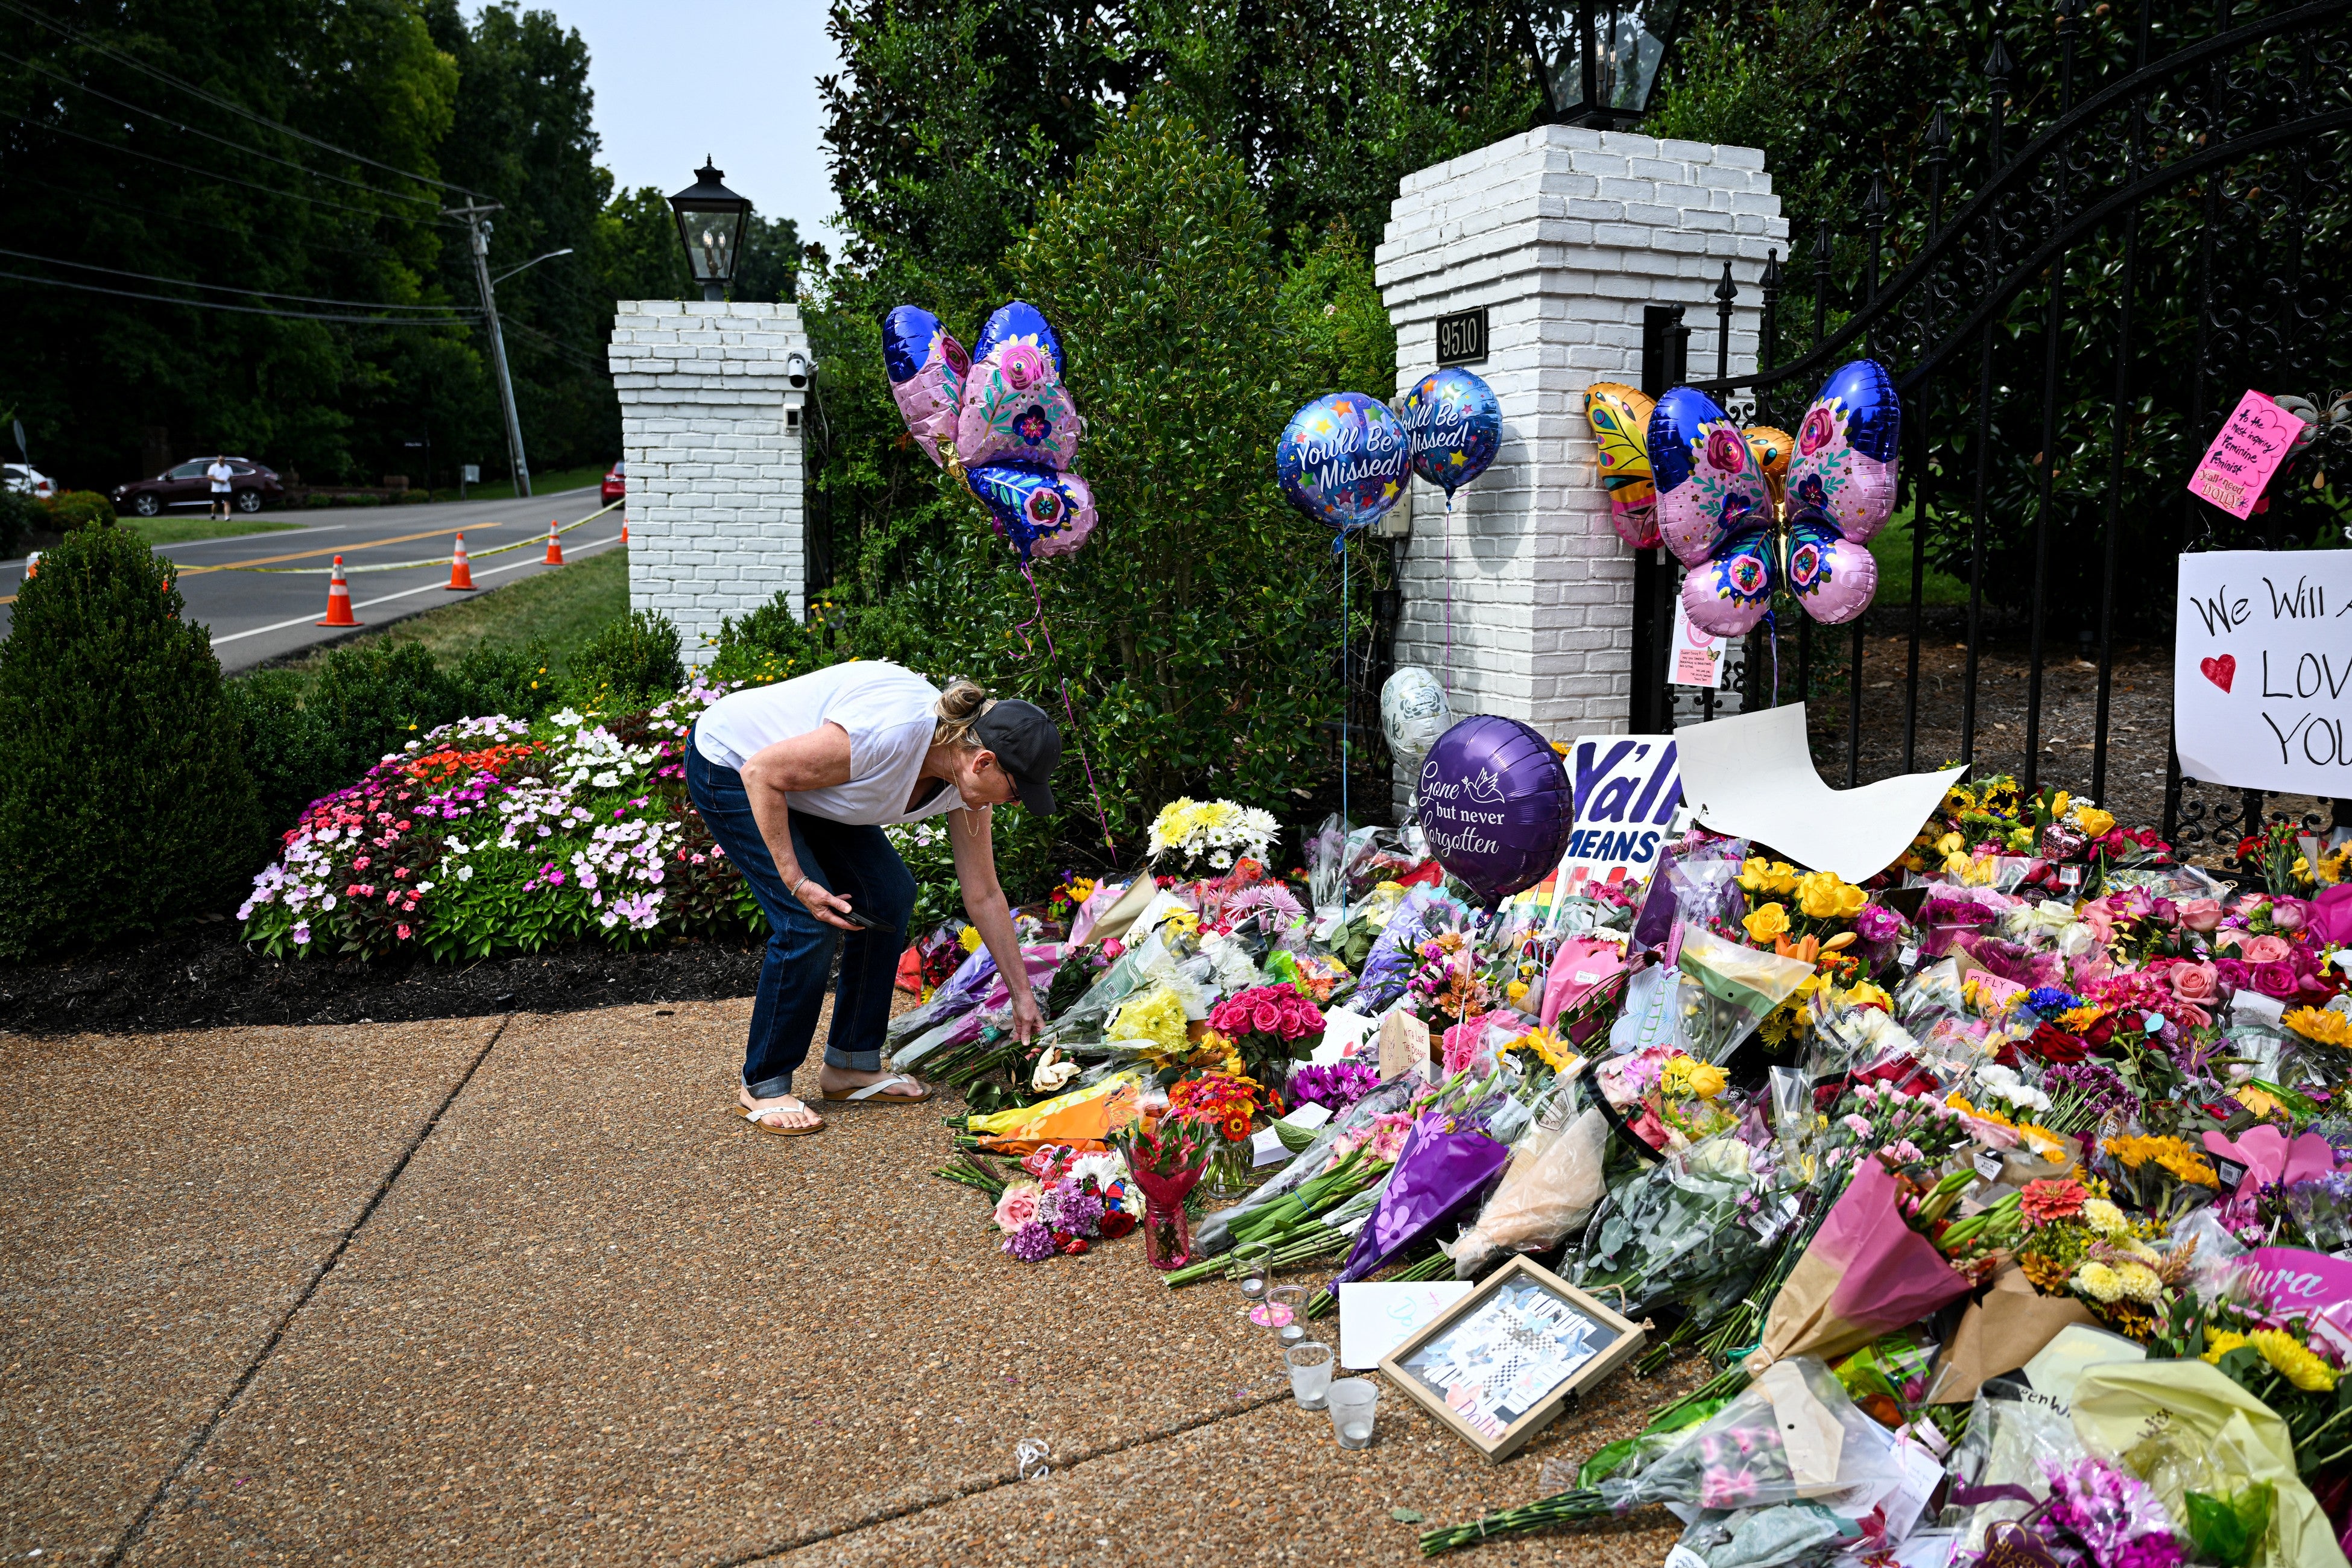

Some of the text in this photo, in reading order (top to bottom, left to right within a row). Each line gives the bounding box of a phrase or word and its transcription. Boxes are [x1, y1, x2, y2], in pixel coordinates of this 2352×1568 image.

[1442, 318, 1478, 357] 9510
[1437, 402, 1459, 427] Be
[2239, 409, 2265, 429] to the
[1297, 426, 1393, 469] You'll Be
[2231, 422, 2279, 454] most inspiring
[1320, 447, 1403, 493] Missed!
[2201, 483, 2242, 510] DOLLY
[2222, 478, 2245, 496] need
[2190, 575, 2324, 637] We Will
[1418, 760, 1460, 808] Gone
[1436, 801, 1505, 826] but never
[1421, 809, 1500, 858] Forgotten
[1567, 829, 1660, 864] MEANS
[1391, 906, 1433, 941] icke
[1984, 976, 2006, 990] FLY
[2233, 1026, 2284, 1037] Sunflowers
[1402, 1042, 1411, 1052] THE
[1385, 1092, 1402, 1102] HAUS
[1388, 1088, 1404, 1096] BLOOM
[1994, 1537, 2044, 1568] BLOO
